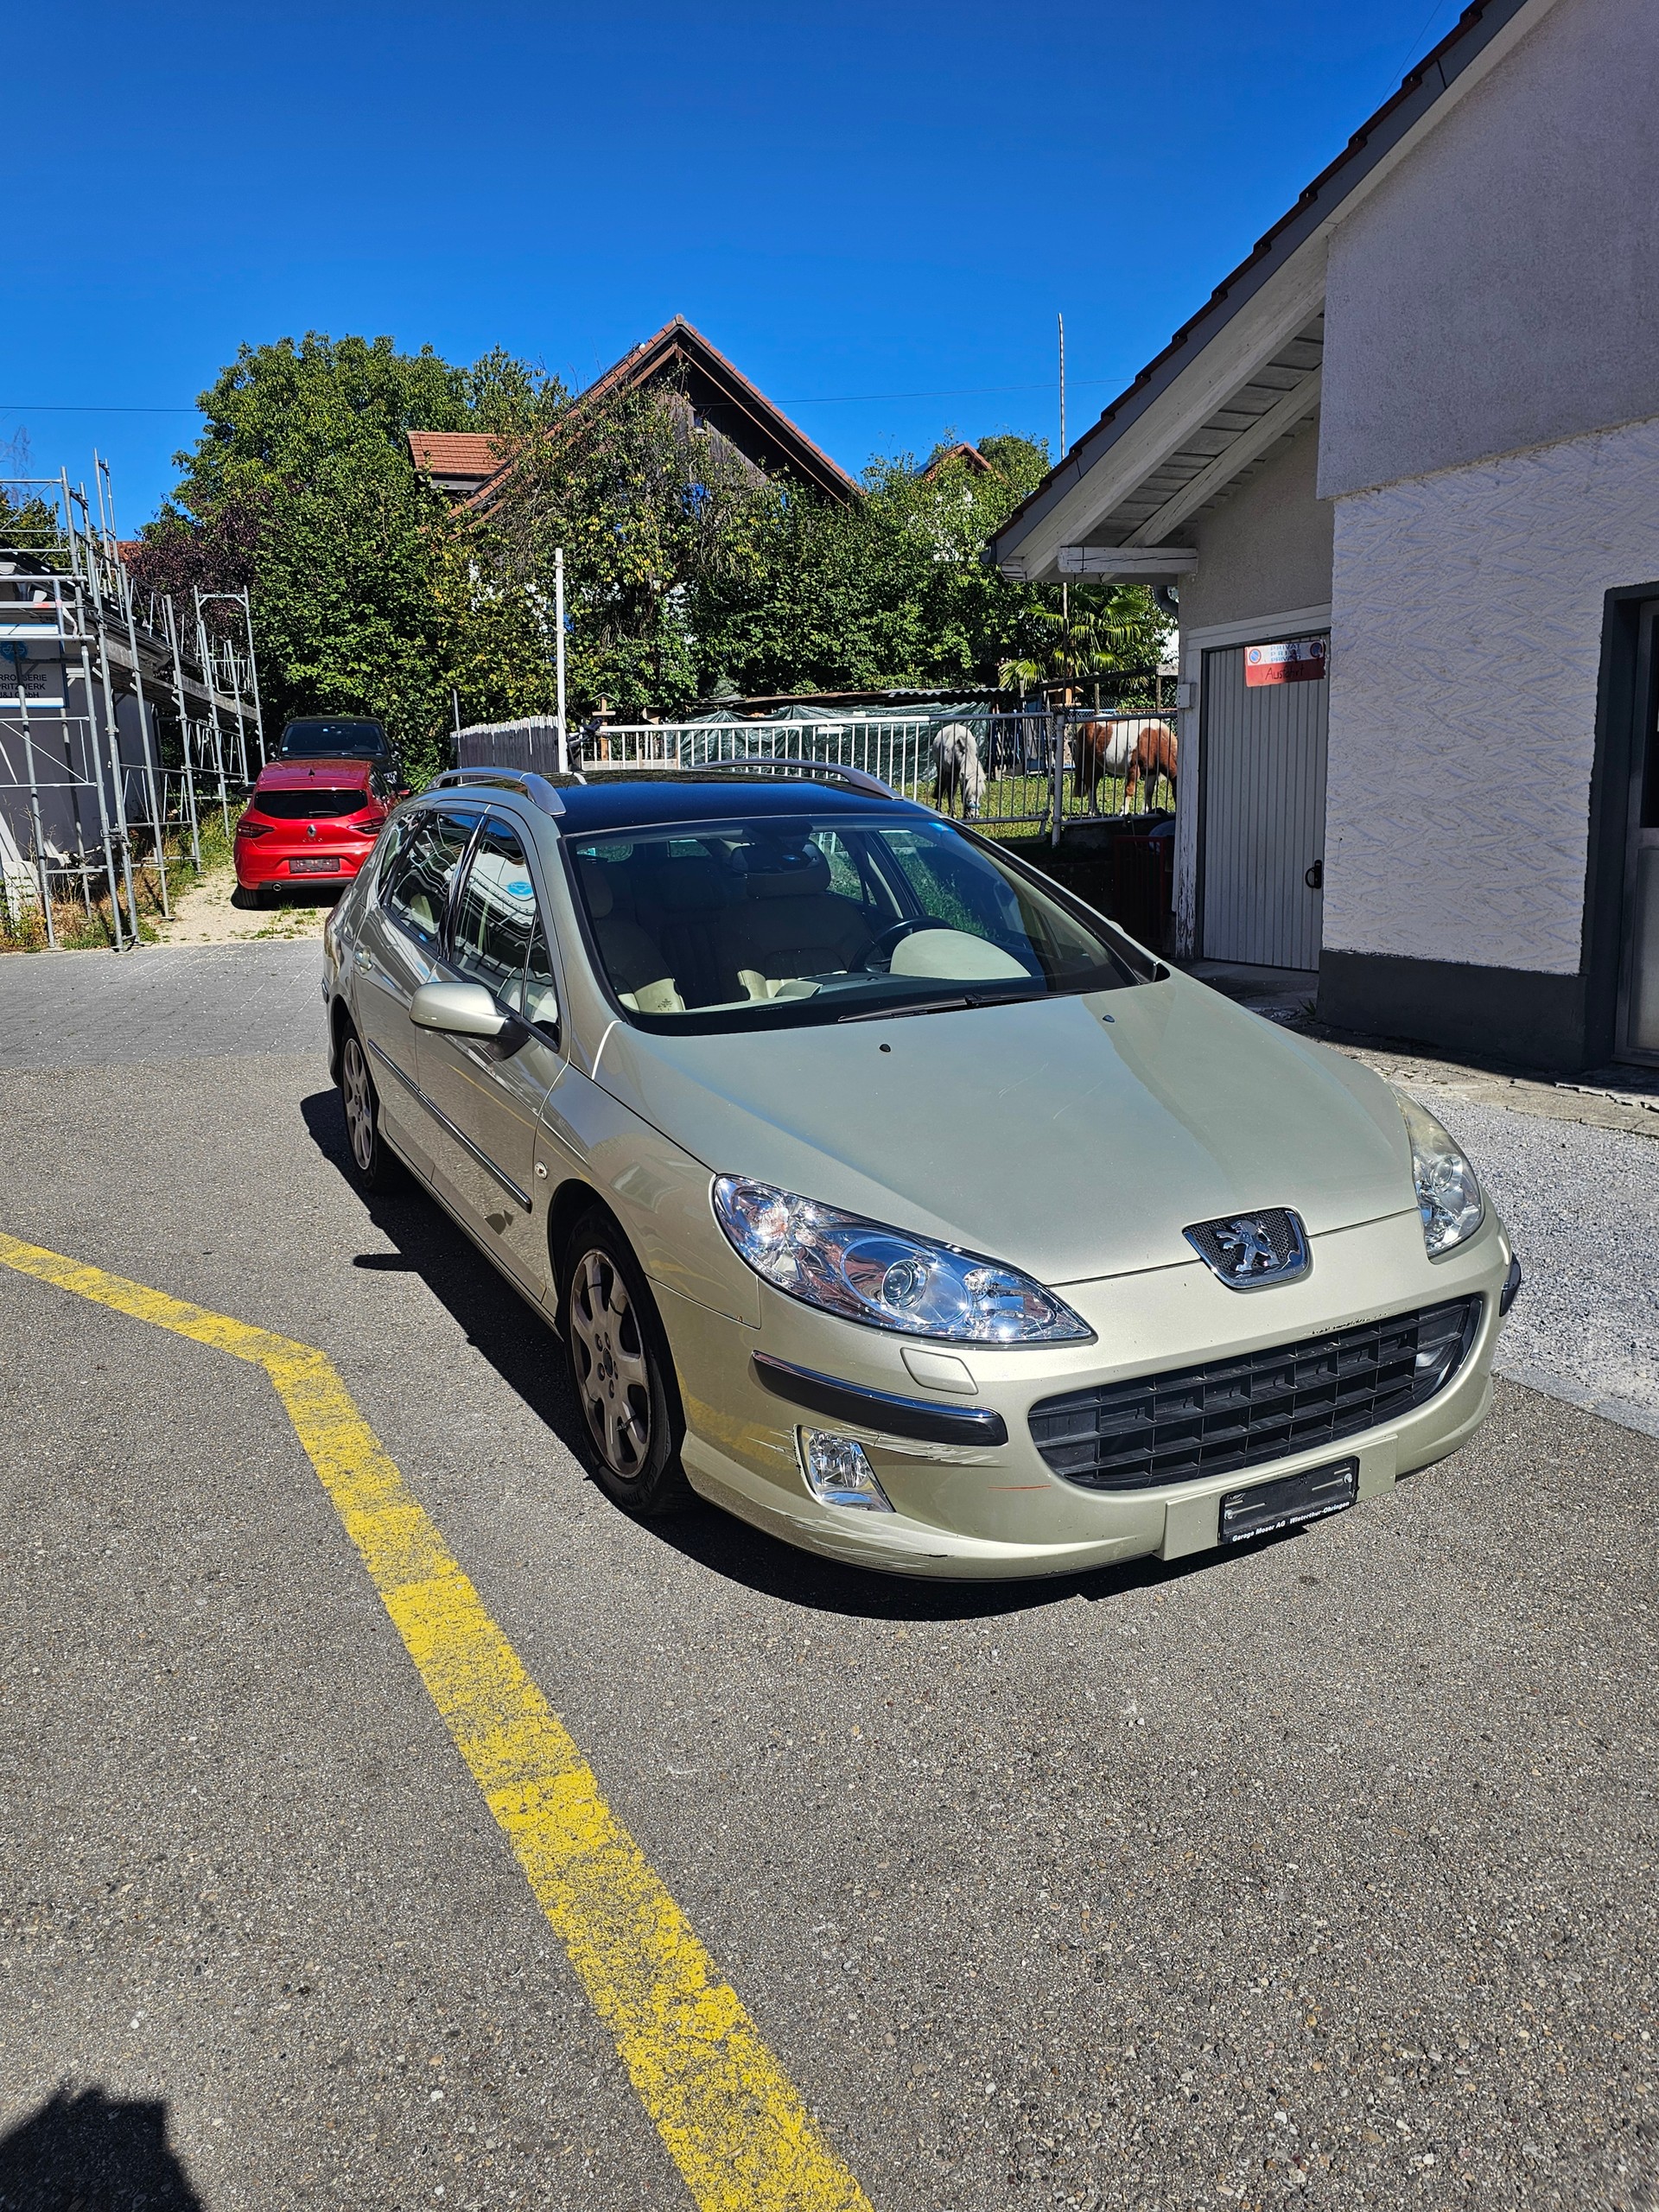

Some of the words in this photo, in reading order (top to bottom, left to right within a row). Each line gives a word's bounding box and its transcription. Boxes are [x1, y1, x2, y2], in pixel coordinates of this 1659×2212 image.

[1265, 664, 1305, 680] Ausfahrt
[1232, 1530, 1255, 1542] Garage
[1255, 1524, 1275, 1535] Moser
[1276, 1520, 1286, 1529] AG
